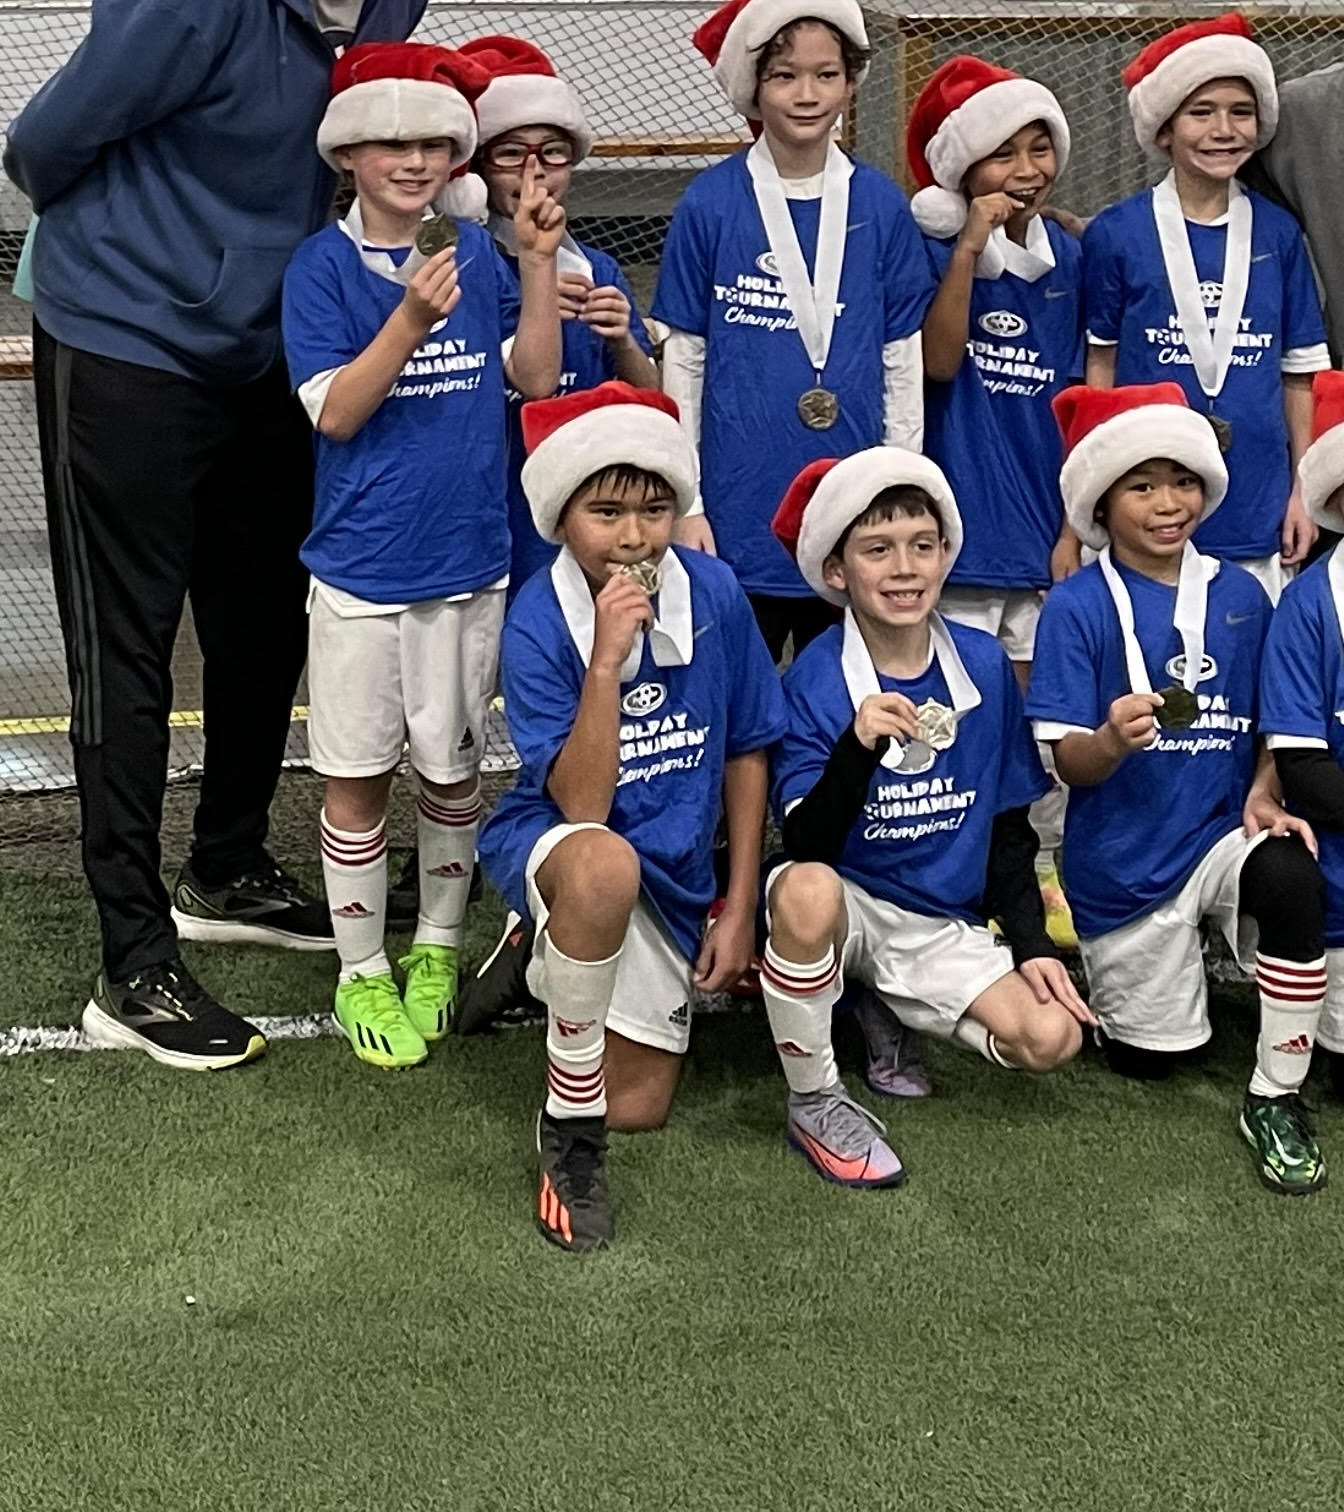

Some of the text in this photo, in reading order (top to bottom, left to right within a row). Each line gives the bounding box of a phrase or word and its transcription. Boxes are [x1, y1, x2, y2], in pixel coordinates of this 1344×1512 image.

[737, 274, 783, 293] HOLI
[714, 285, 846, 317] TOURNAT
[724, 306, 798, 332] Champi
[968, 340, 1040, 363] OLIDAY
[399, 352, 487, 377] RNAMENT
[974, 355, 1055, 382] RNAMENT
[387, 373, 481, 398] hampions!
[877, 777, 955, 802] HOLIDAY
[864, 791, 977, 820] OURNAMENT
